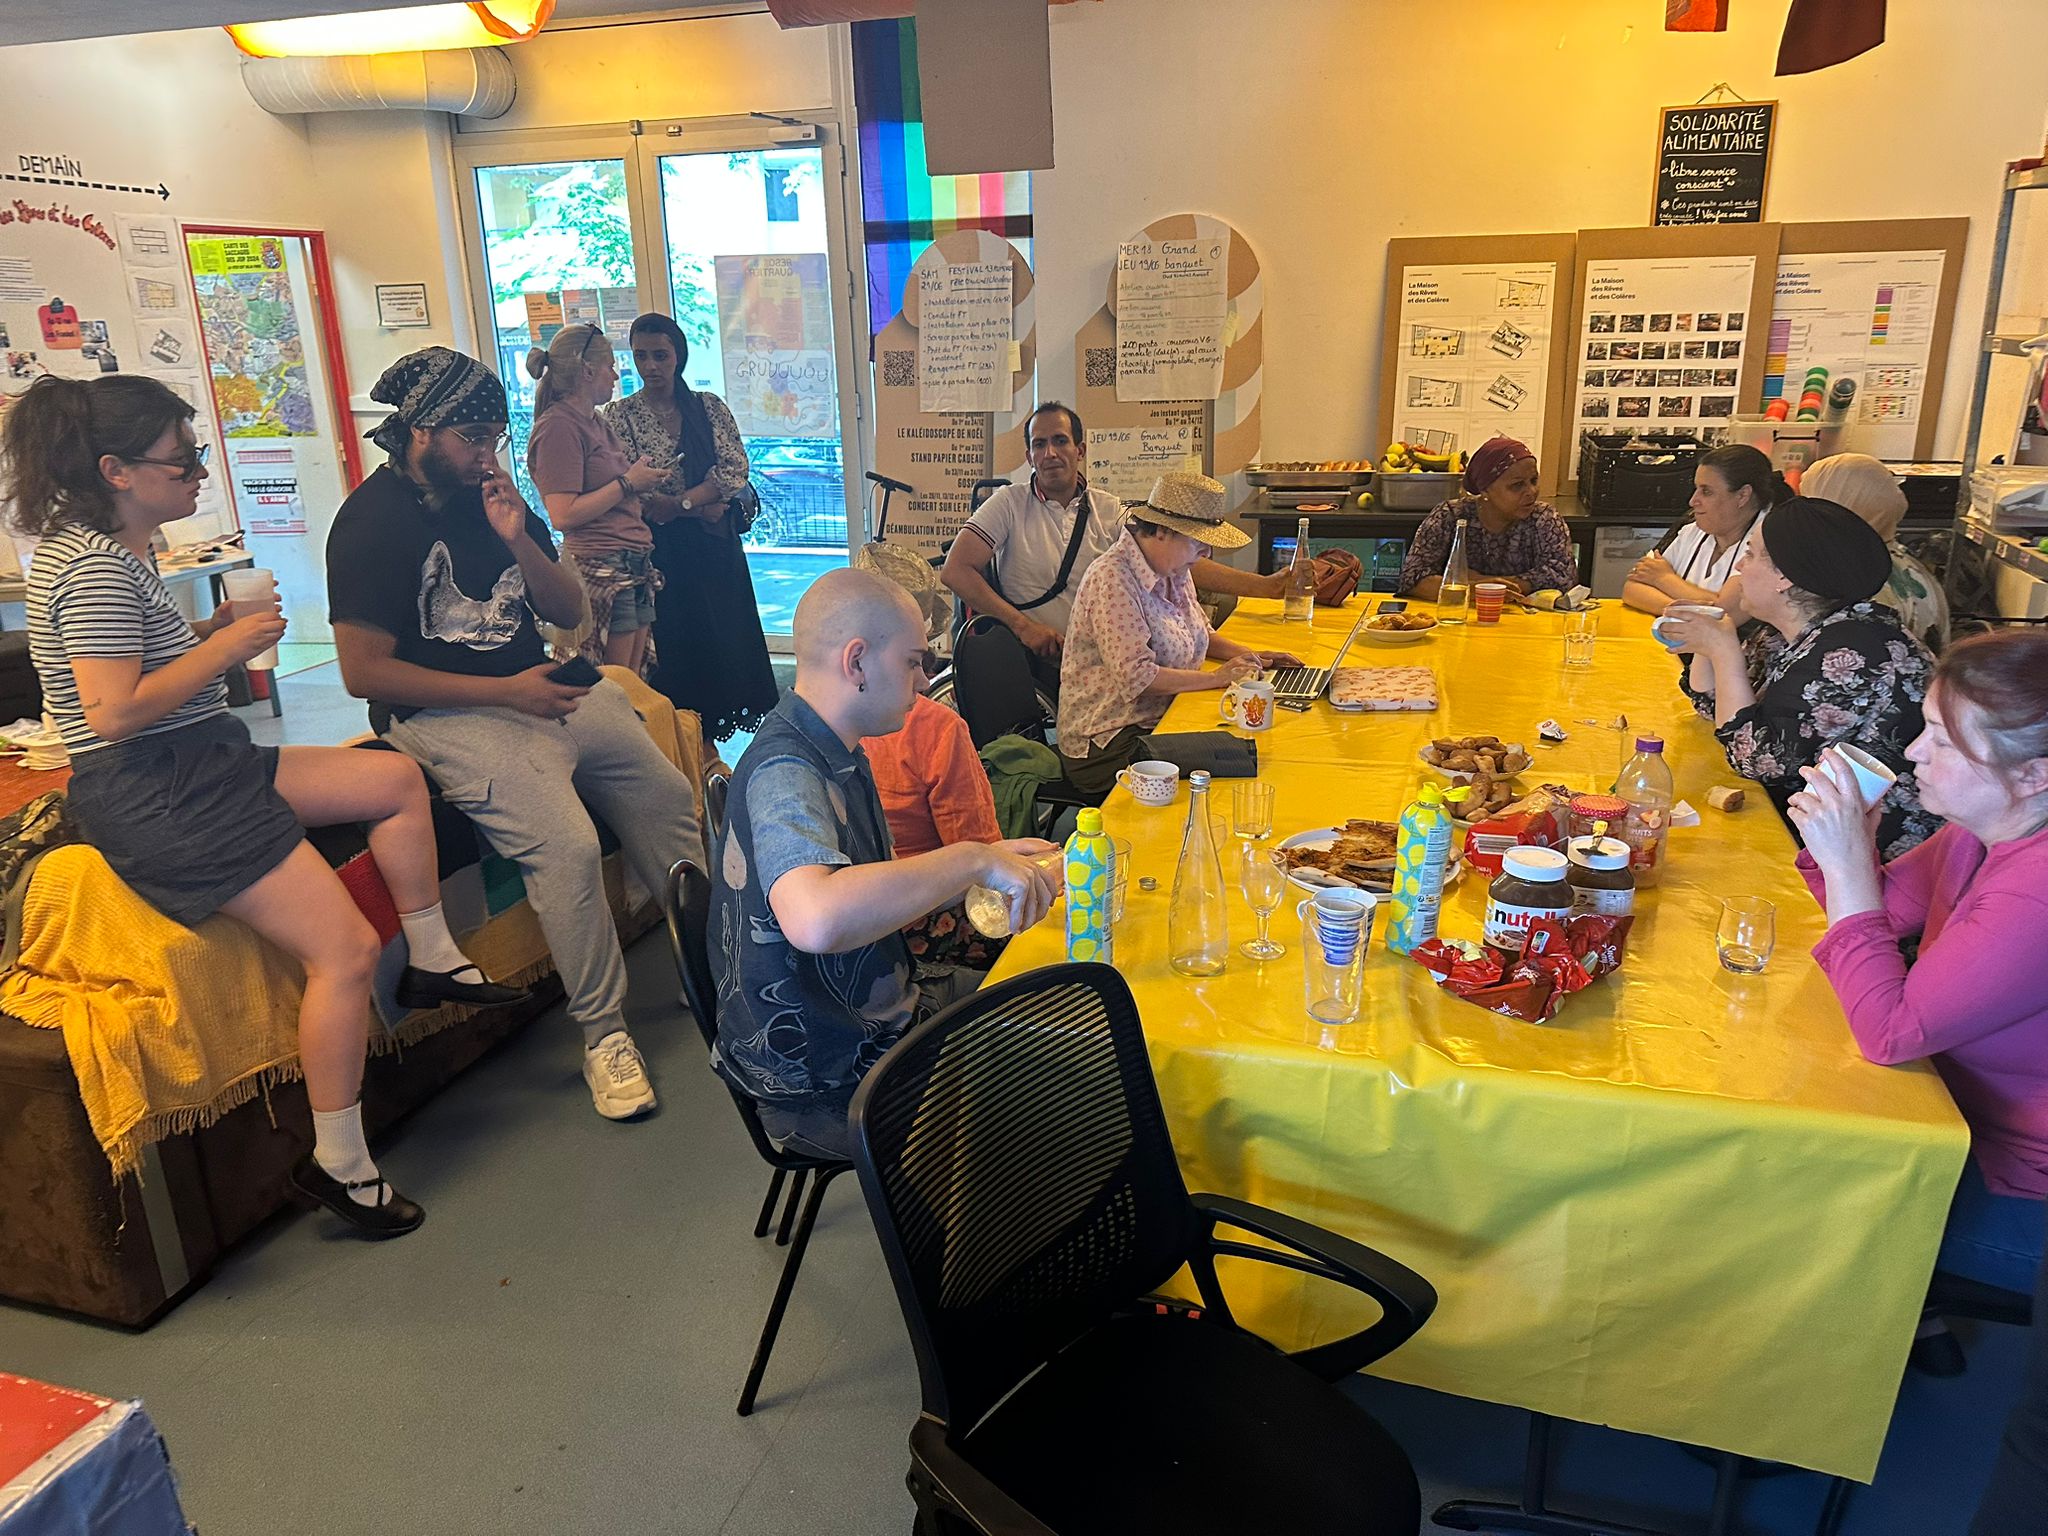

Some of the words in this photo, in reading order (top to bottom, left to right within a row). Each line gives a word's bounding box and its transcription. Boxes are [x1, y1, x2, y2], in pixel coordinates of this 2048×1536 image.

[1670, 159, 1699, 178] libre
[1699, 166, 1738, 177] service
[1119, 244, 1140, 255] MER
[1161, 242, 1197, 255] Grand
[897, 428, 905, 438] LE
[906, 426, 956, 439] KALÉIDOSCOPE
[957, 429, 966, 439] DE
[1141, 430, 1169, 441] Grand
[911, 453, 932, 463] STAND
[933, 453, 956, 463] PAPIER
[958, 452, 984, 464] CADEAU
[908, 501, 937, 511] CONCERT
[939, 502, 953, 512] SUR
[953, 502, 961, 512] LE
[886, 523, 935, 535] DÉAMBULATION
